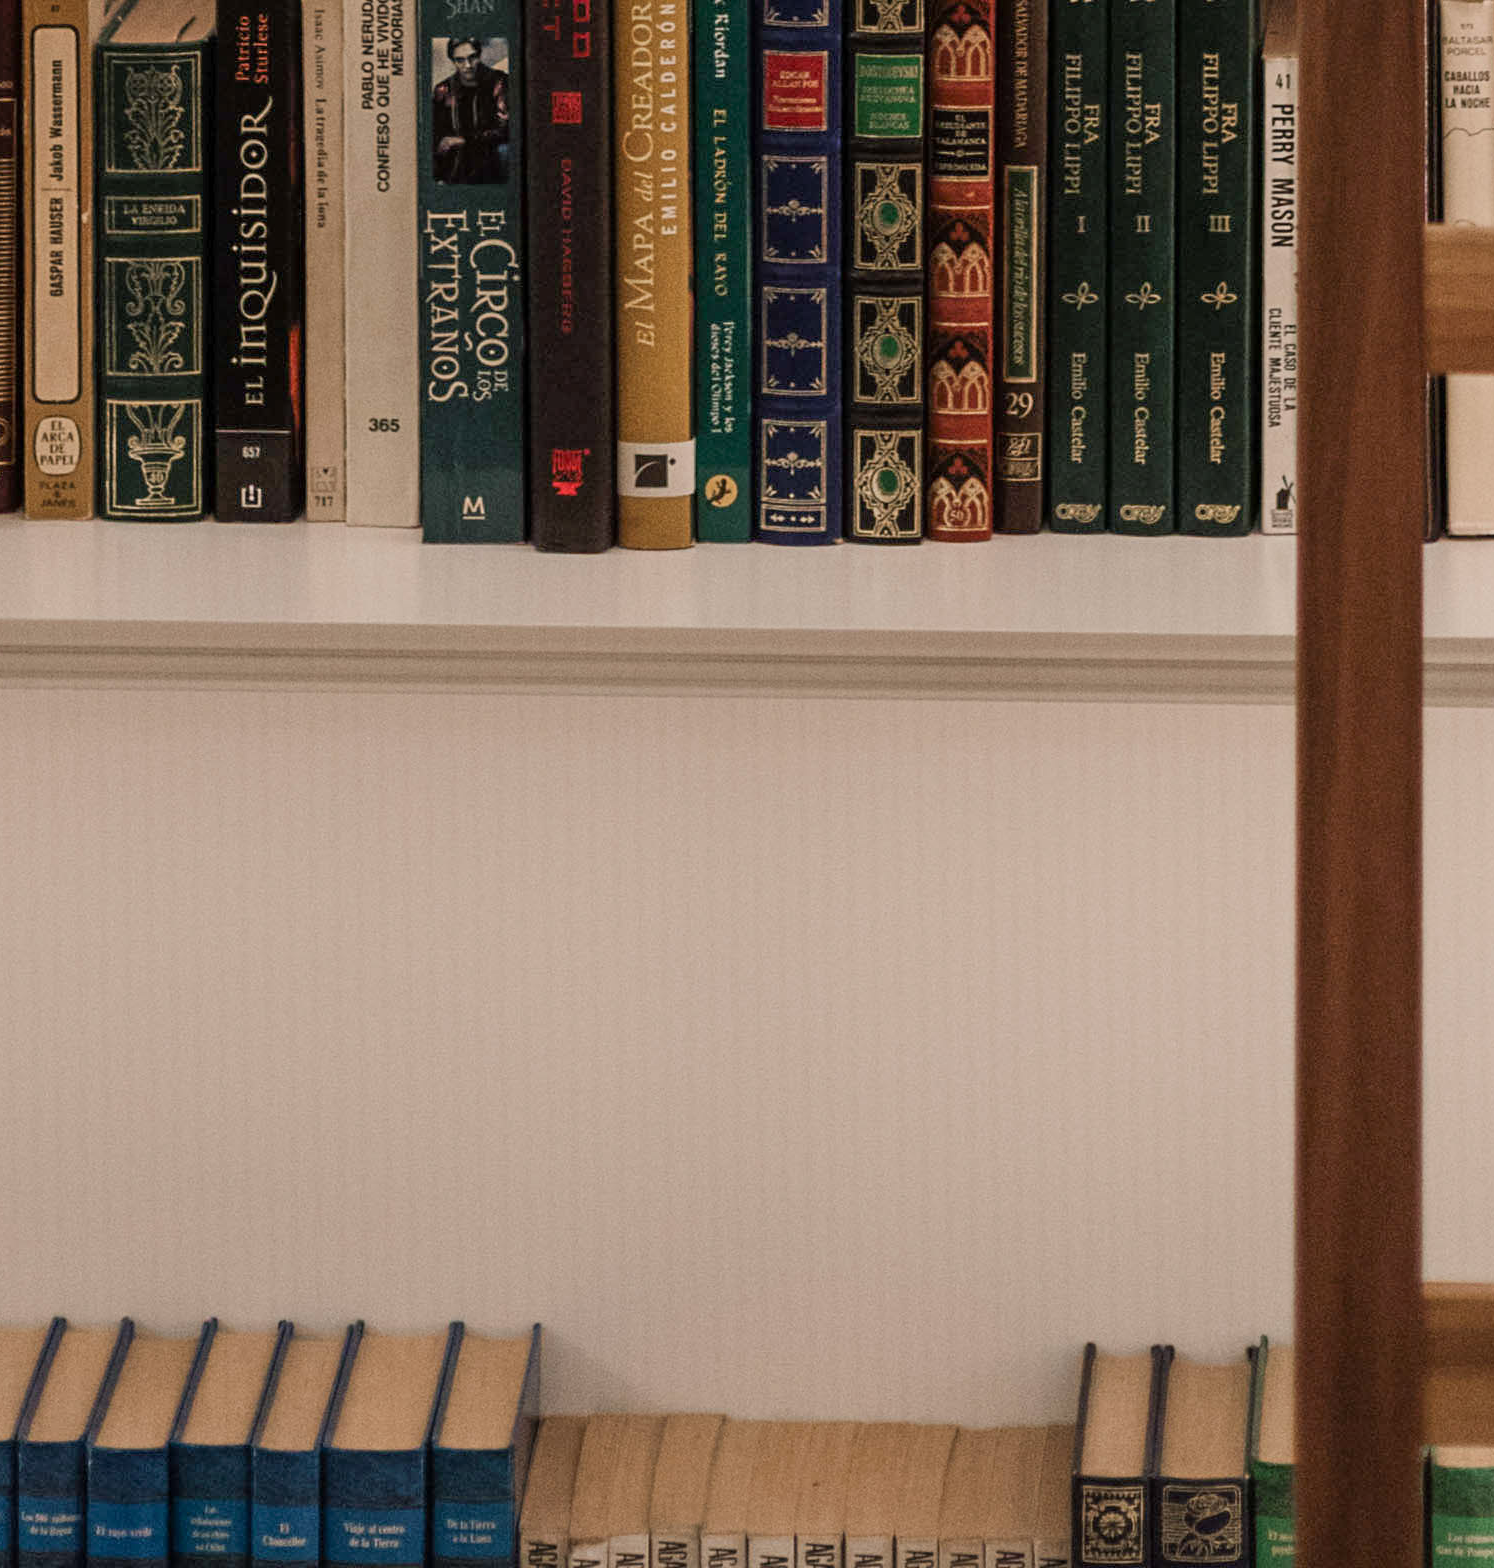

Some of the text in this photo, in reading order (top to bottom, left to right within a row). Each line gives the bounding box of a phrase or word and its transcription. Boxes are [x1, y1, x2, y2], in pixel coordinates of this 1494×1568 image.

[235, 14, 250, 82] Patricio
[256, 13, 269, 84] Sturlese
[377, 48, 389, 69] HE
[362, 61, 374, 109] PABLO
[377, 75, 390, 107] QUE
[656, 3, 677, 235] EMILIO CALDERÓN
[377, 113, 390, 192] CONFIESO
[1272, 103, 1294, 249] PERRY MASON
[634, 172, 653, 201] del
[636, 321, 655, 347] El
[369, 418, 400, 433] 365
